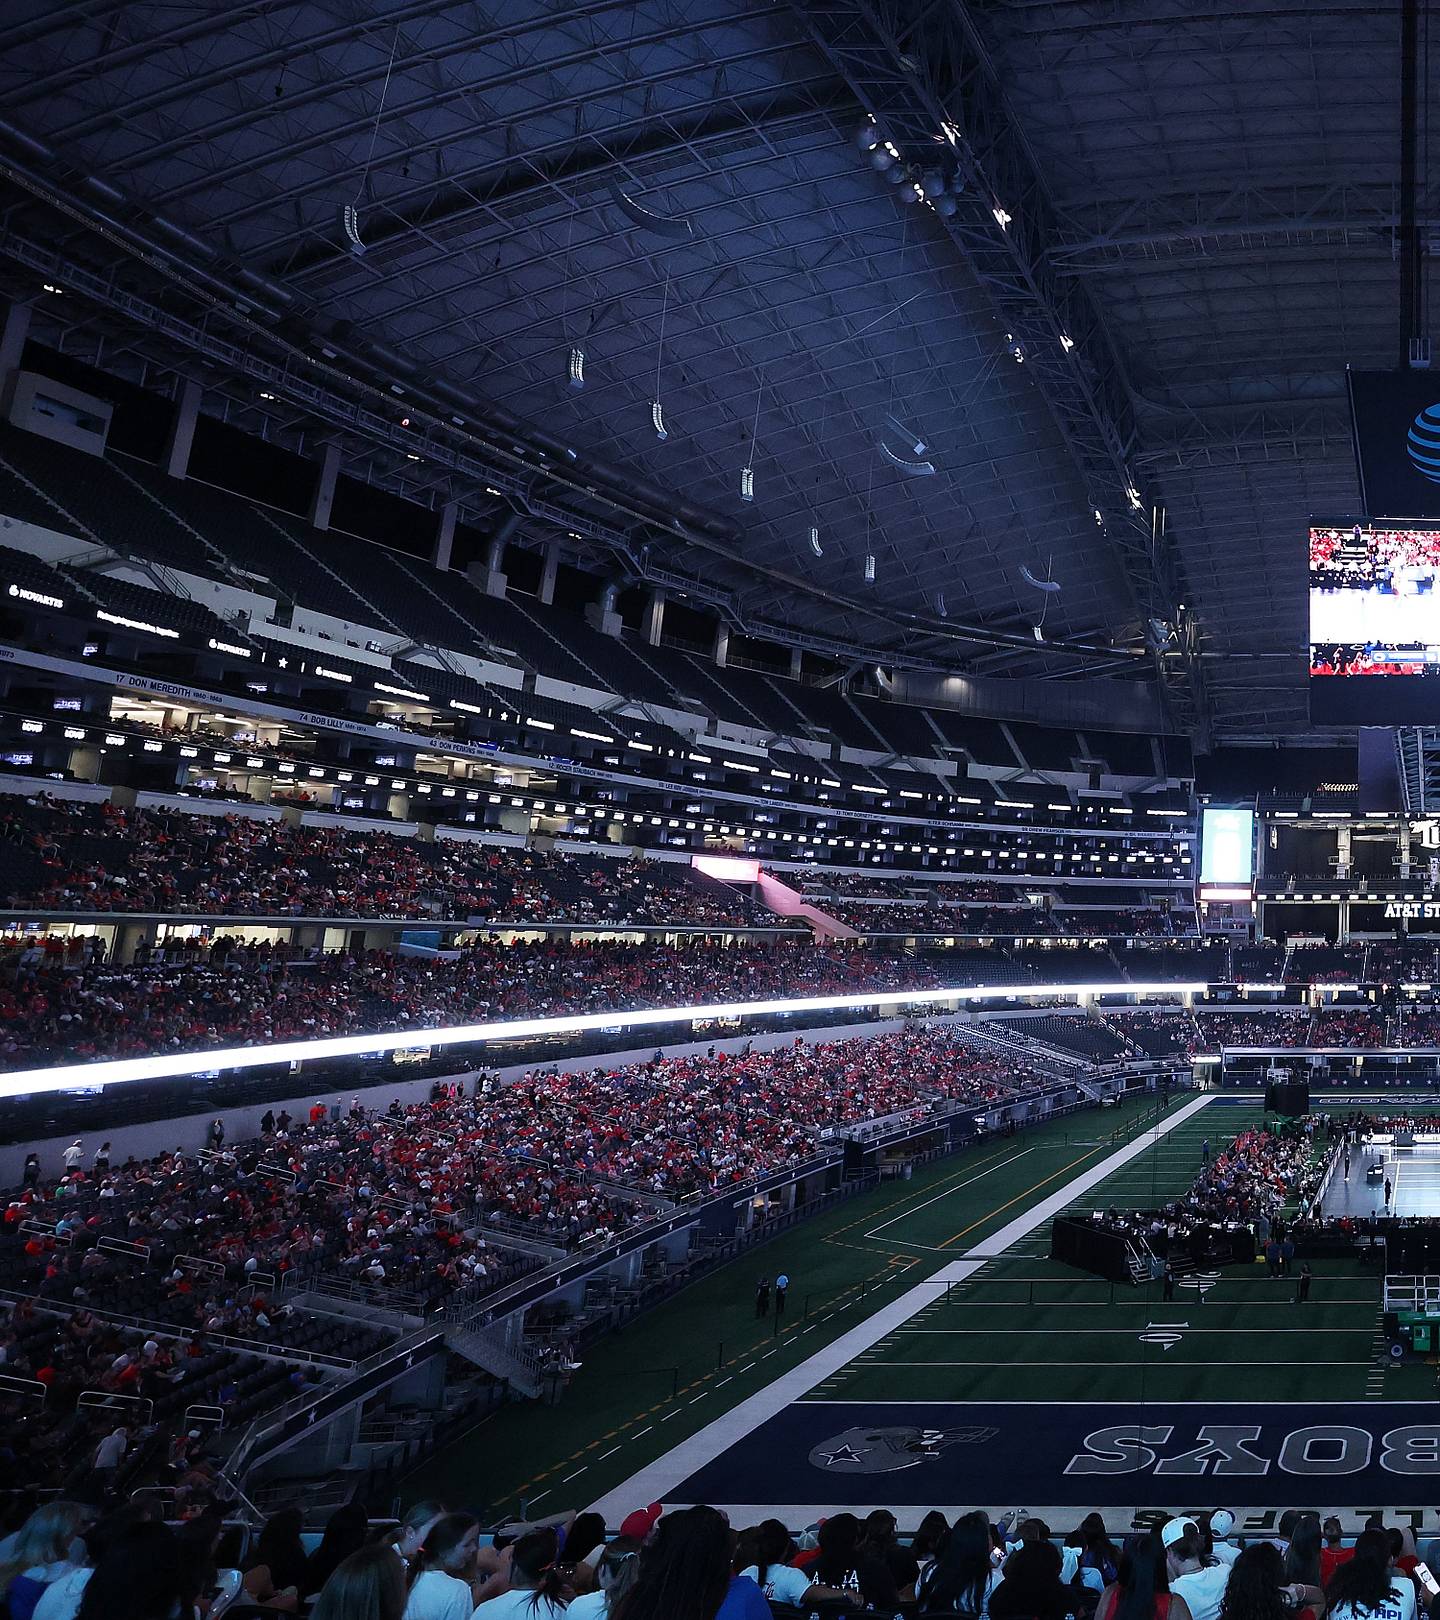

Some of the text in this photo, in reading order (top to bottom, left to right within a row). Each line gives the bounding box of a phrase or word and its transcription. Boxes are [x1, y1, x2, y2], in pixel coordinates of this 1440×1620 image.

[116, 674, 125, 683] 17
[129, 676, 147, 689] DON
[150, 681, 191, 698] MEREDITH
[311, 715, 326, 725] BOB
[327, 719, 344, 729] LILLY
[1384, 903, 1421, 918] AT&T
